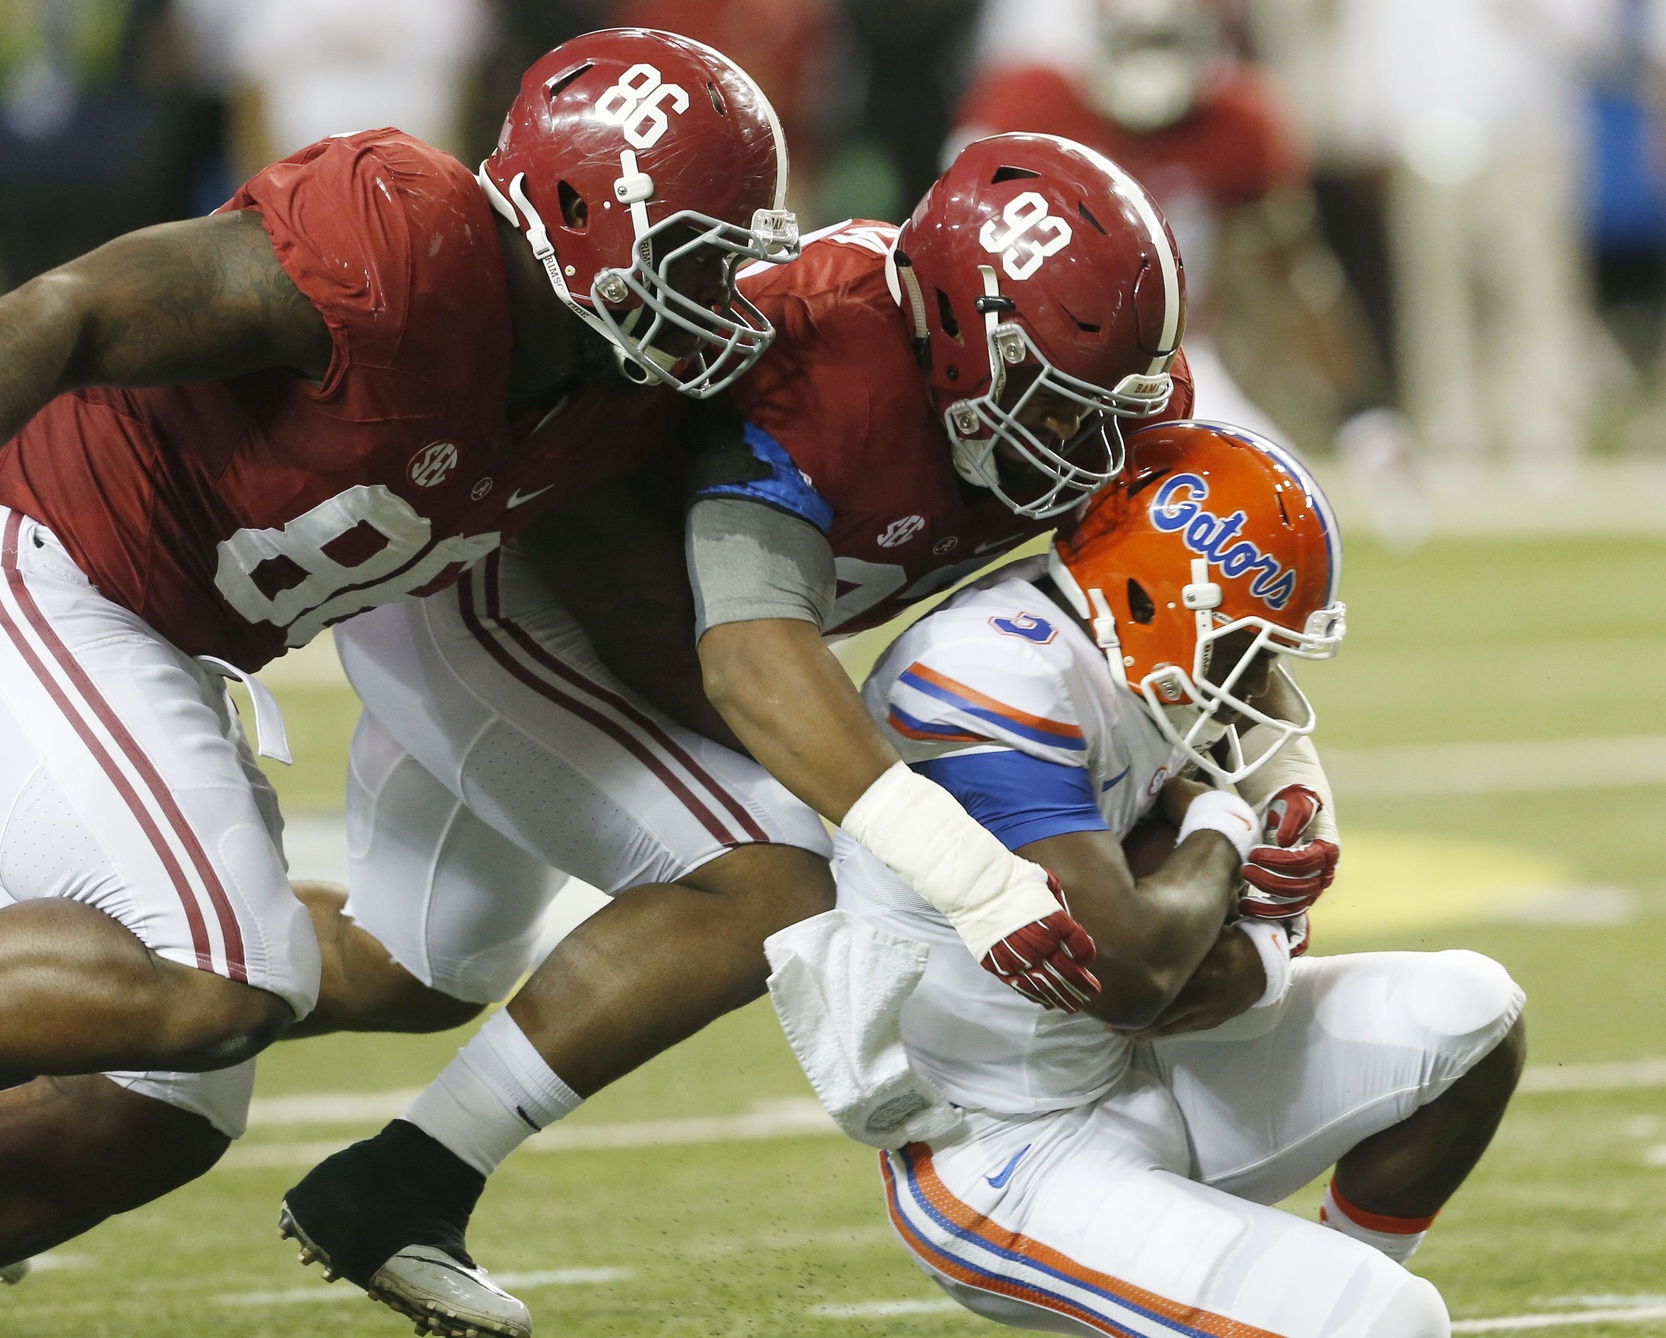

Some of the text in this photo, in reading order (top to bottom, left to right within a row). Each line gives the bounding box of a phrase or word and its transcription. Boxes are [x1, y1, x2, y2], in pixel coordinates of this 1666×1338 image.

[595, 63, 690, 149] 86
[979, 191, 1073, 280] 93
[545, 256, 589, 319] RIMS TIDE
[411, 442, 458, 488] SEC
[876, 514, 926, 548] SEC
[1151, 472, 1296, 611] Gators
